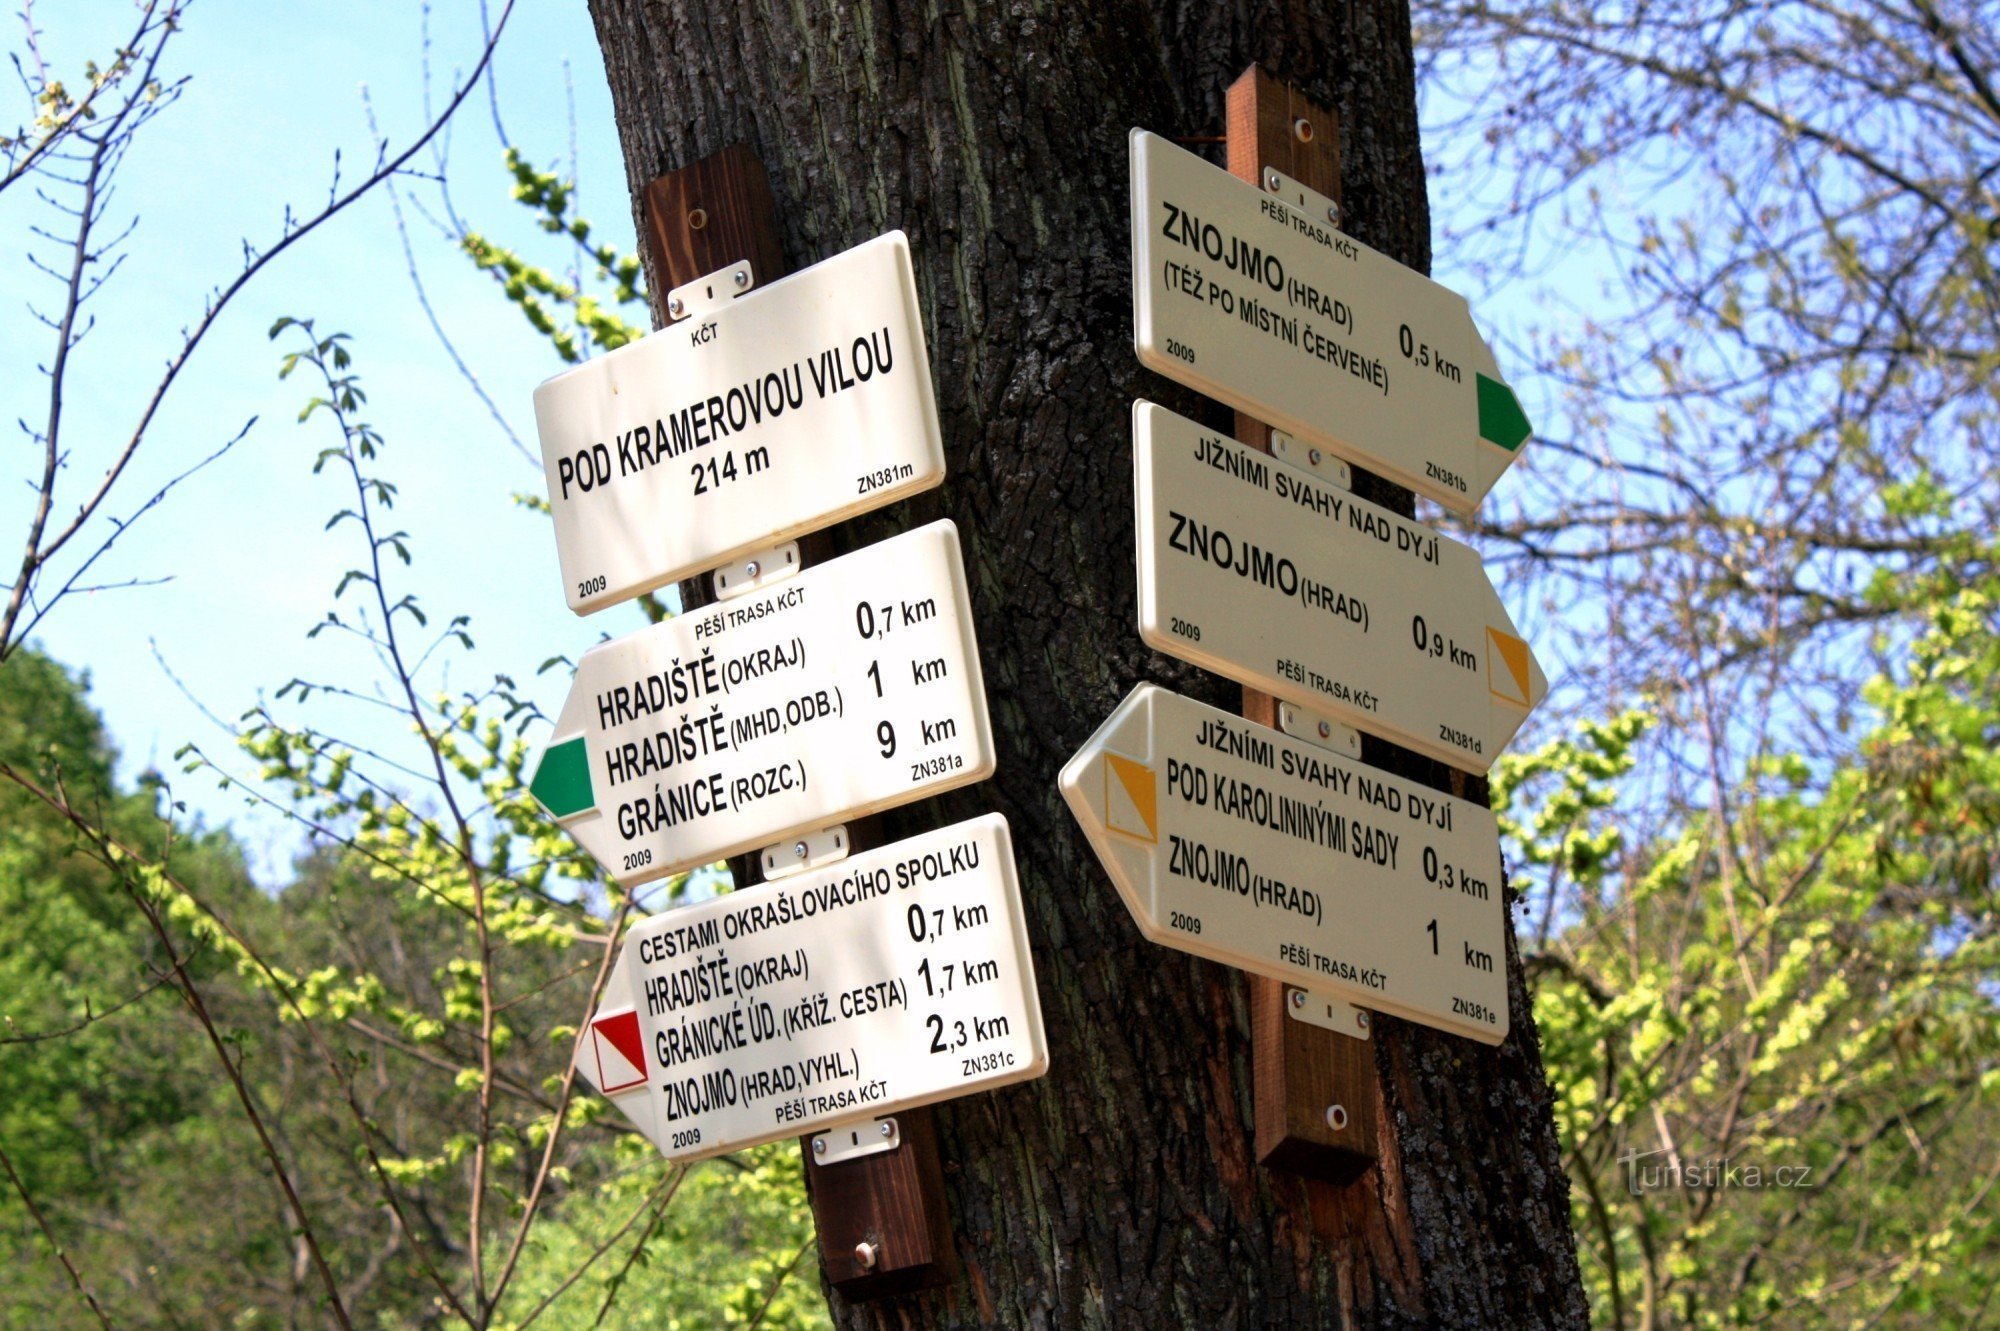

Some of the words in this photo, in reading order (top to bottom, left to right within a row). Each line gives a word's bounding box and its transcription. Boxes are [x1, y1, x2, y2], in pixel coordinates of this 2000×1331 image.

[1261, 200, 1288, 226] PĚŠÍ
[1291, 213, 1332, 246] TRASA
[1335, 234, 1359, 262] KČT
[691, 323, 719, 347] KČT
[1167, 338, 1195, 364] 2009
[1209, 282, 1234, 314] PO
[1240, 293, 1298, 347] MÍSTNÍ
[1303, 324, 1389, 396] ČERVENÉ)
[1435, 351, 1461, 384] km
[559, 443, 611, 499] POD
[617, 363, 801, 477] KRAMEROVOU
[807, 327, 893, 399] VILOU
[691, 452, 737, 496] 214
[745, 446, 770, 473] m
[857, 463, 913, 494] ZN381m
[1426, 462, 1467, 493] ZN381b
[1194, 437, 1269, 490] JIŽNÍMI
[1276, 472, 1343, 522] SVAHY
[1349, 504, 1390, 543] NAD
[1397, 526, 1439, 565] DYJÍ
[578, 576, 607, 598] 2009
[695, 615, 725, 640] PĚŠÍ
[730, 603, 775, 630] TRASA
[778, 588, 804, 614] KČT
[902, 599, 936, 626] km
[1171, 617, 1201, 641] 2009
[1449, 639, 1476, 672] km
[867, 660, 882, 698] 1
[912, 658, 946, 685] km
[1277, 659, 1305, 684] PĚŠÍ
[1308, 672, 1350, 703] TRASA
[1354, 691, 1378, 712] KČT
[877, 721, 896, 759] 9
[921, 718, 956, 745] km
[1440, 724, 1482, 755] ZN381d
[911, 754, 963, 781] ZN381a
[1197, 719, 1274, 769] JIŽNÍMI
[1282, 749, 1351, 794] SVAHY
[1358, 777, 1401, 813] NAD
[1408, 794, 1452, 832] DYJÍ
[1168, 758, 1208, 801] POD
[1214, 774, 1347, 854] KAROLININÝMI
[1352, 821, 1399, 870] SADY
[1460, 869, 1488, 901] km
[624, 849, 652, 871] 2009
[640, 918, 720, 964] CESTAMI
[723, 868, 891, 940] OKRAŠLOVACÍHO
[897, 841, 979, 889] SPOLKU
[953, 902, 989, 929] km
[1171, 912, 1201, 934] 2009
[1426, 919, 1439, 956] 1
[1464, 941, 1493, 972] km
[1280, 944, 1310, 968] PĚŠÍ
[1313, 954, 1358, 982] TRASA
[1361, 968, 1386, 990] KČT
[656, 997, 747, 1068] GRÁNICKÉ
[748, 996, 781, 1042] ÚD.
[840, 978, 907, 1019] CESTA)
[964, 957, 999, 986] km
[1452, 997, 1495, 1024] ZN381e
[974, 1013, 1009, 1042] km
[962, 1052, 1014, 1076] ZN381c
[776, 1097, 806, 1123] PĚŠÍ
[809, 1088, 857, 1115] TRASA
[860, 1081, 887, 1107] KČT
[672, 1128, 701, 1149] 2009
